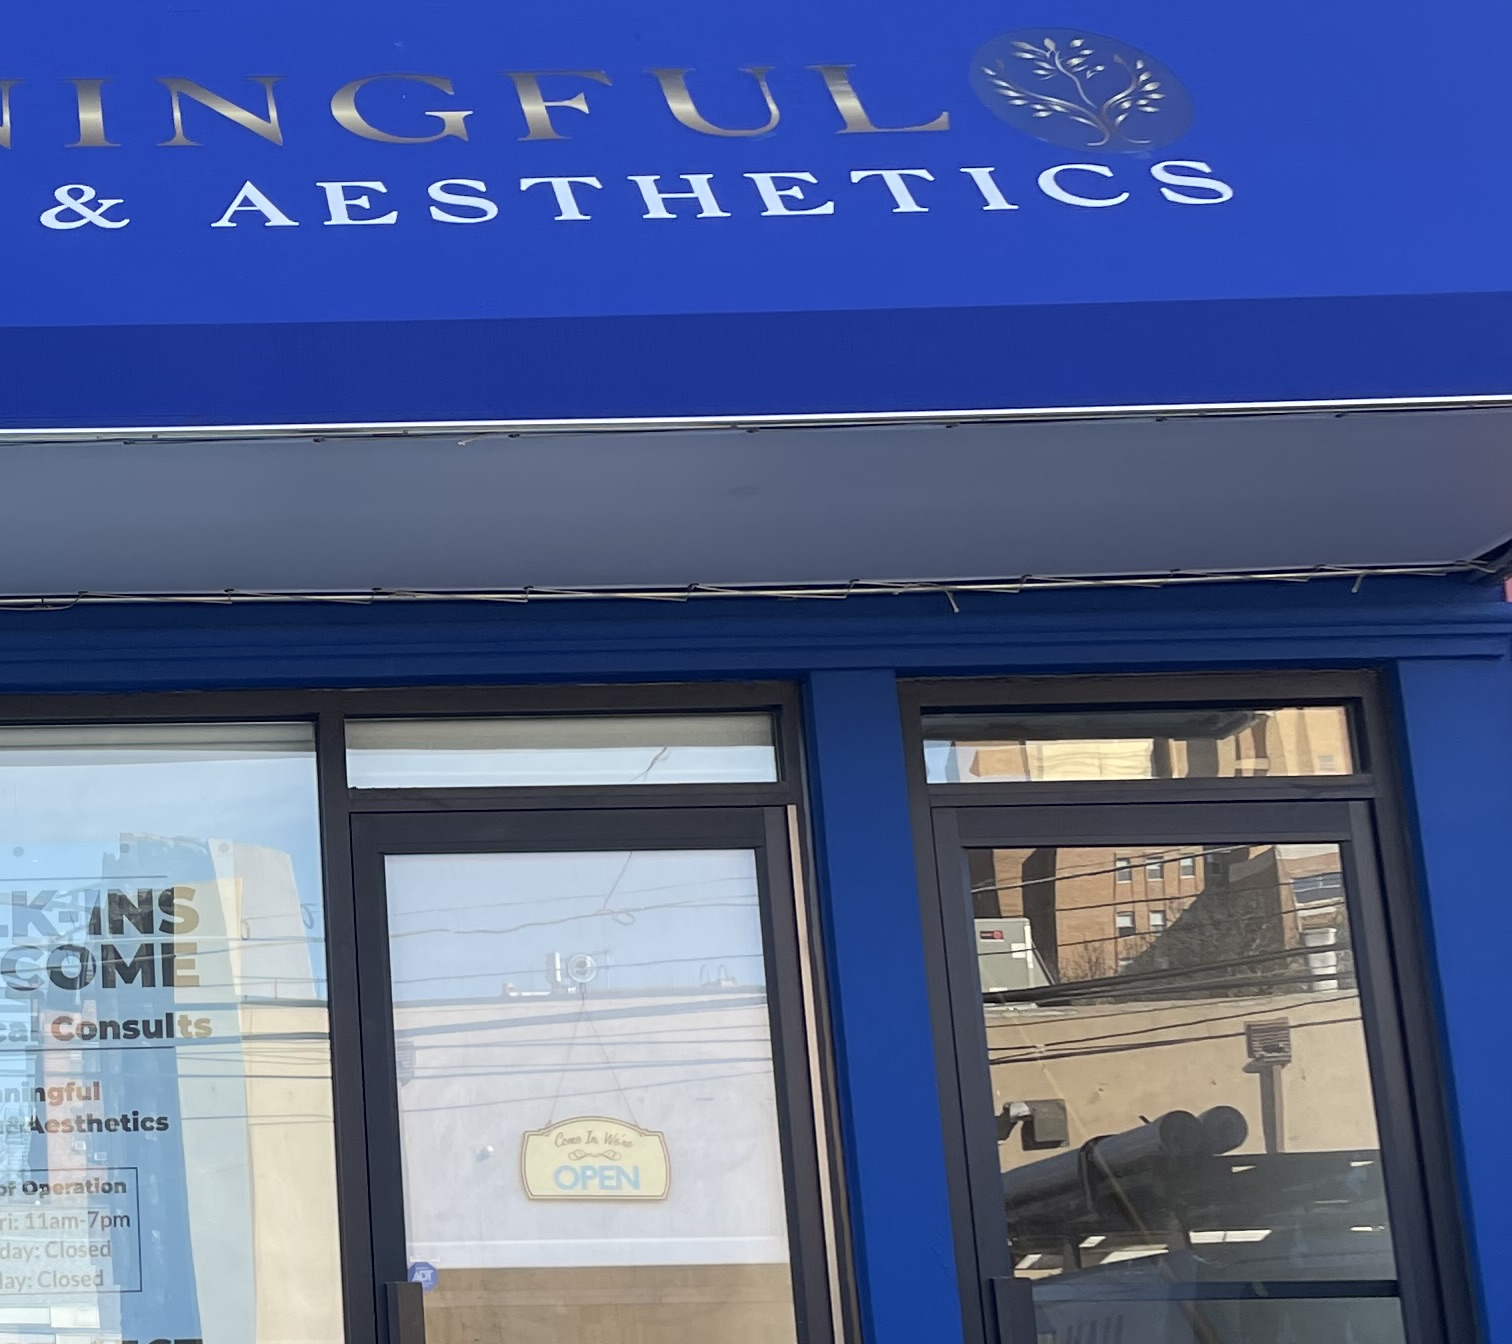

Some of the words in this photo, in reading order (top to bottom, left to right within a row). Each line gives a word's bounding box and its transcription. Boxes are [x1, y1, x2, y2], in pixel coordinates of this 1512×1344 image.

[39, 184, 130, 231] &
[210, 158, 1236, 229] AESTHETICS
[50, 1012, 213, 1042] Consults
[22, 1176, 128, 1199] Operation
[553, 1164, 641, 1191] OPEN
[25, 1209, 132, 1233] 11am-7pm
[44, 1239, 112, 1260] Closed
[36, 1269, 105, 1289] Closed
